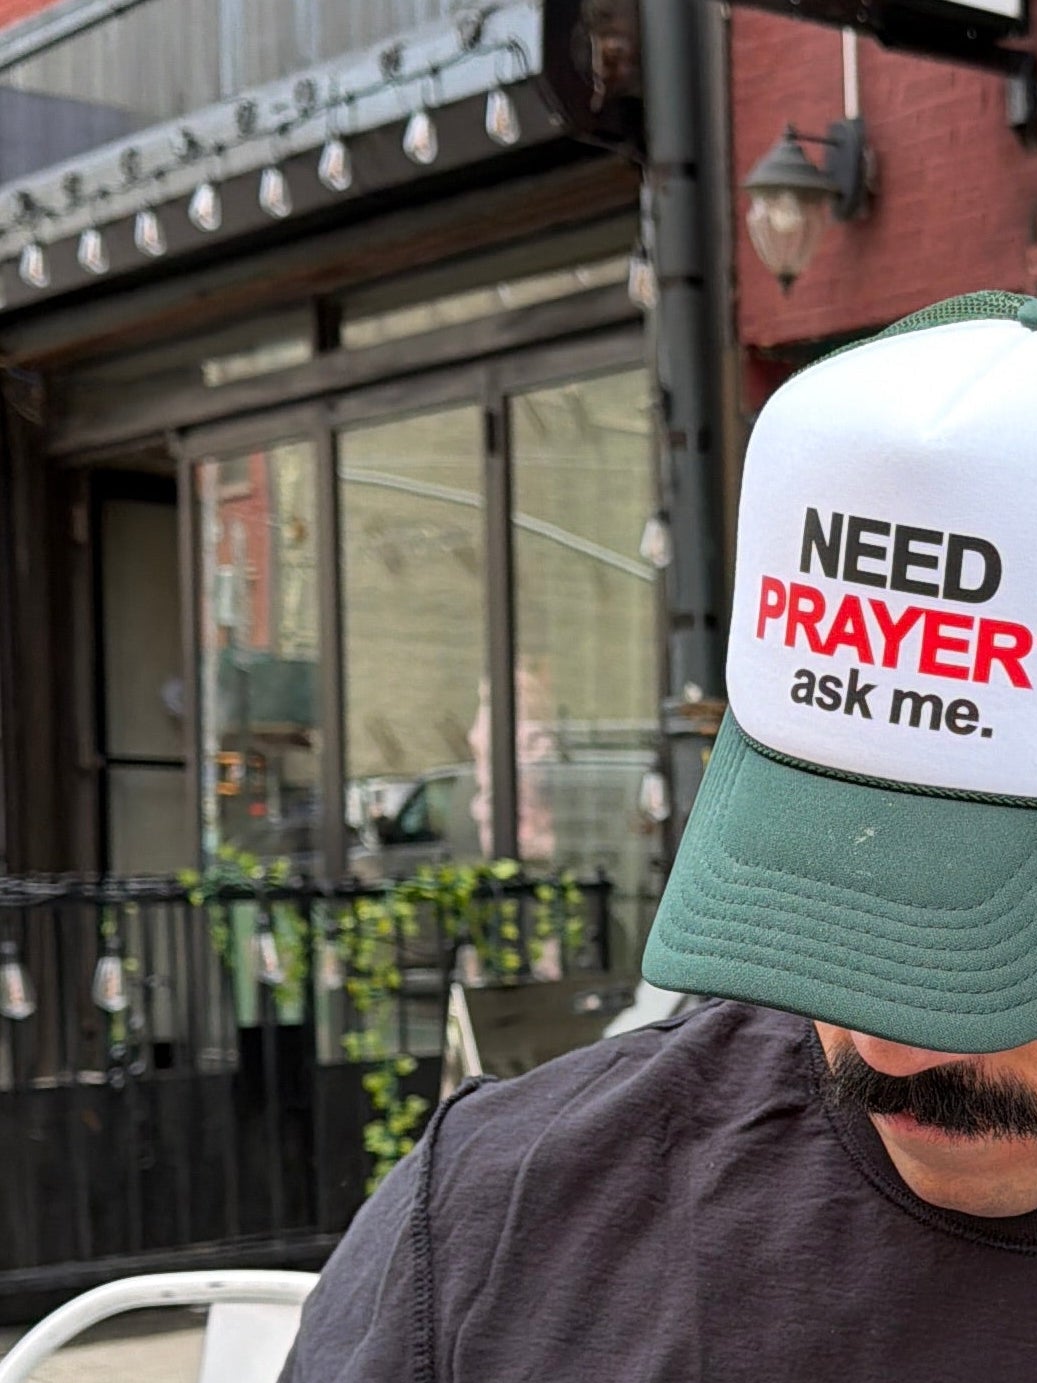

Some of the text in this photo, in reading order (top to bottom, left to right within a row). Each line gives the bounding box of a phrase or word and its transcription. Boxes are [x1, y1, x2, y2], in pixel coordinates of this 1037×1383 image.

[799, 506, 1003, 604] NEED
[789, 667, 994, 739] ask me.
